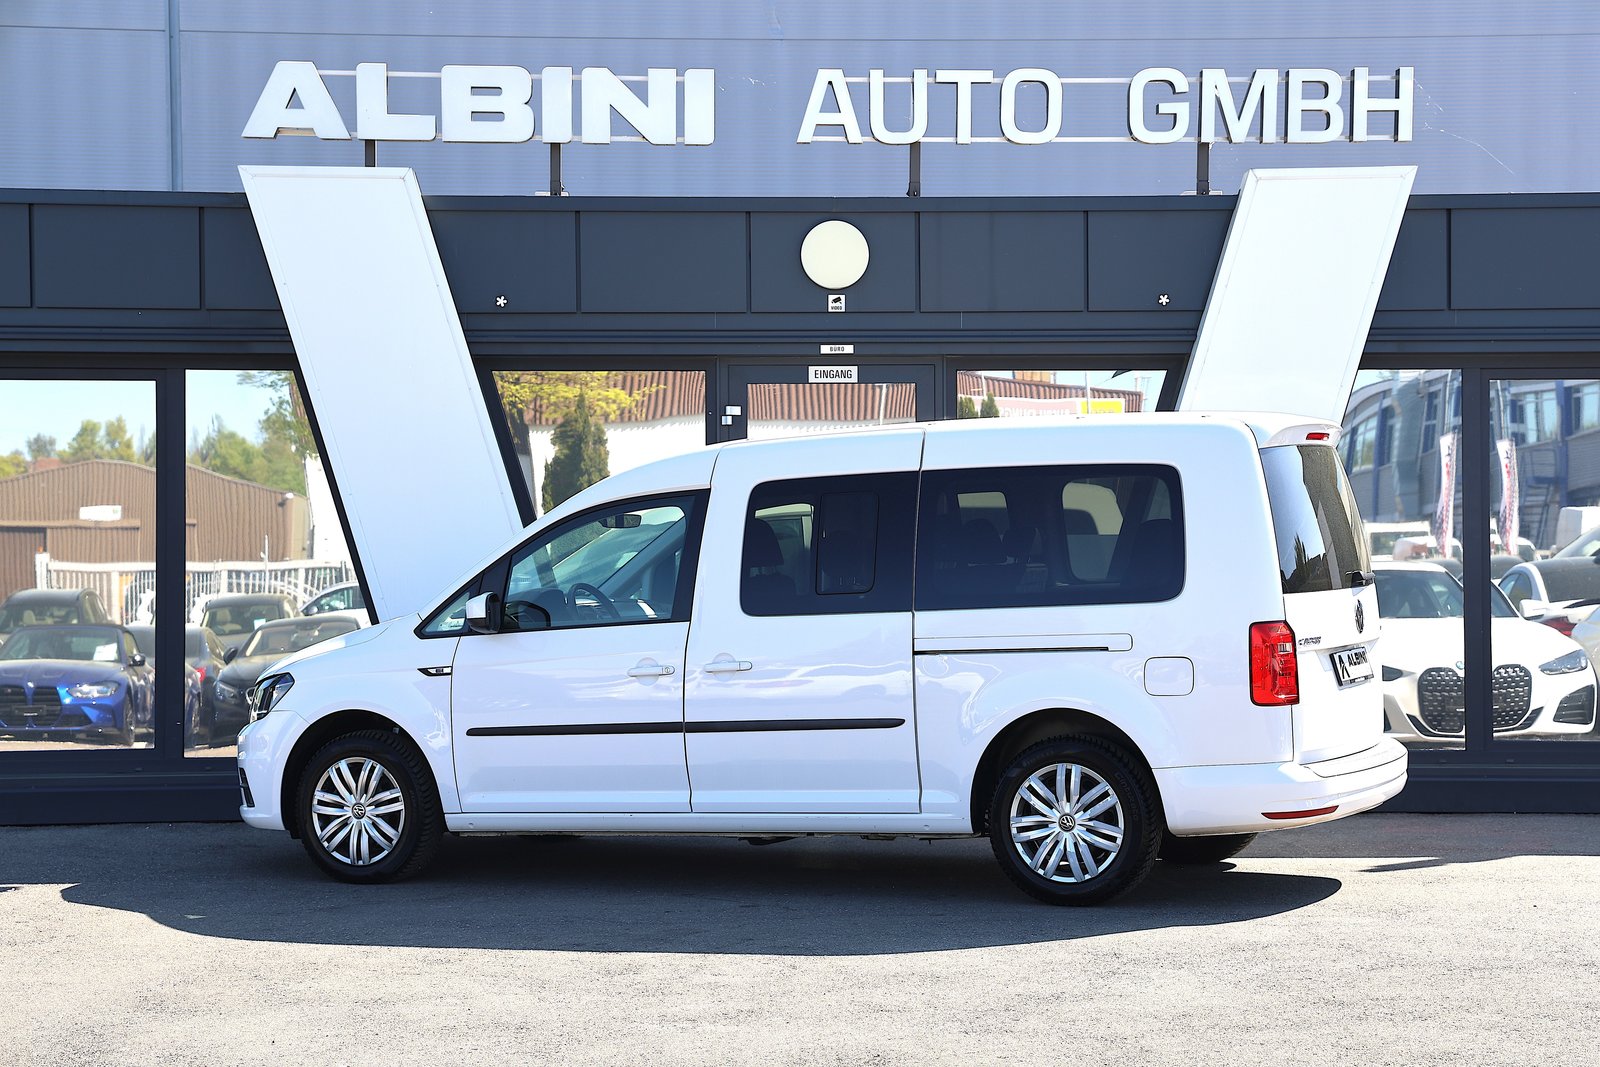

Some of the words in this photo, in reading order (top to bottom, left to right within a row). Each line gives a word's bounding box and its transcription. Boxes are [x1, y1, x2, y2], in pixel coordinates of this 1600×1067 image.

[241, 60, 715, 145] ALBINI
[796, 67, 1063, 145] AUTO
[1127, 66, 1414, 144] GMBH
[814, 369, 853, 379] EINGANG
